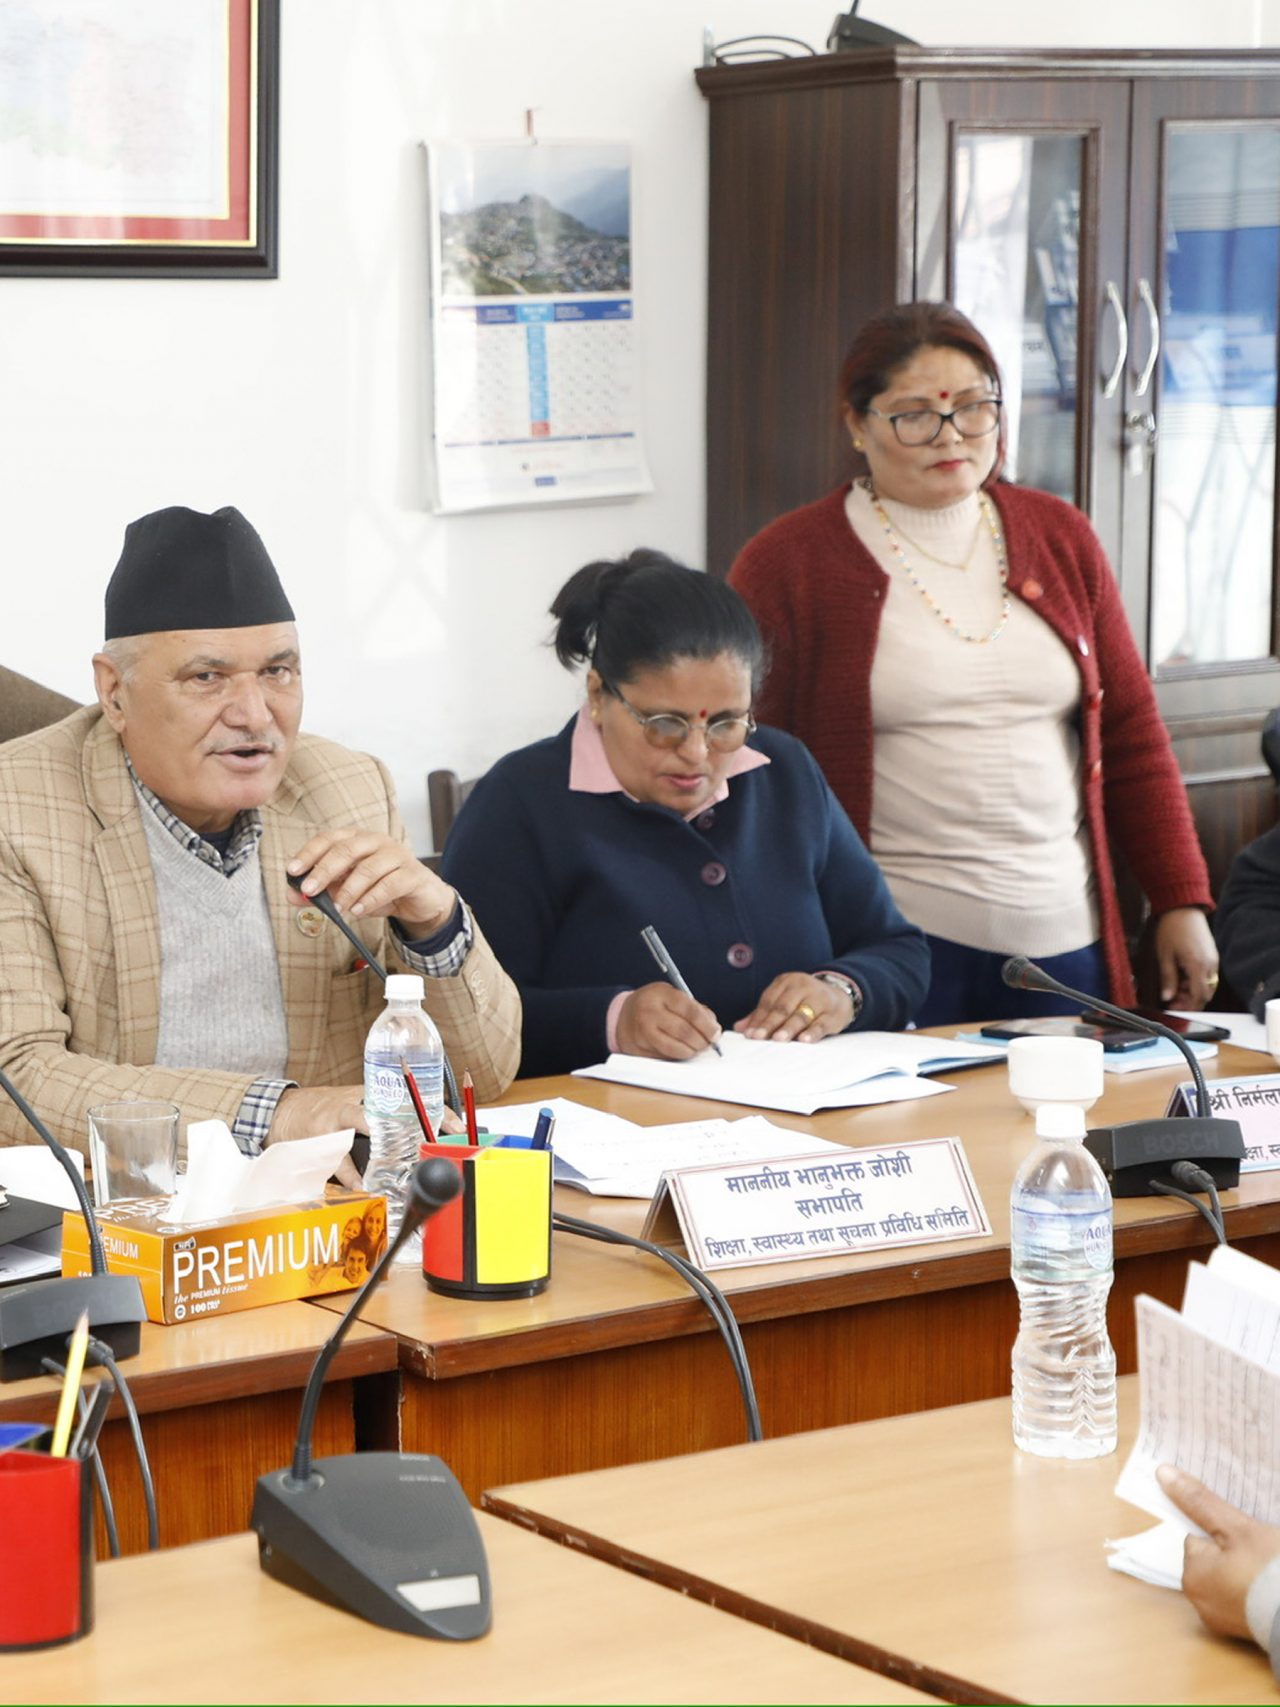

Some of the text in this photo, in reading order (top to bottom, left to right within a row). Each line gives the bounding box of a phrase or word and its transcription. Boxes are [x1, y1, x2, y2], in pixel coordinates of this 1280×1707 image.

[1208, 1084, 1280, 1111] श्री निर्मल
[1143, 1131, 1219, 1156] BOSCH
[725, 1150, 913, 1194] माननीय भानुभक्त जोशी
[794, 1187, 864, 1219] सभापति
[88, 1235, 139, 1260] EMIUM
[704, 1205, 970, 1258] शिक्षा, स्वास्थ्य तथा सूचना प्रविधि समिति
[173, 1223, 340, 1295] PREMIUM
